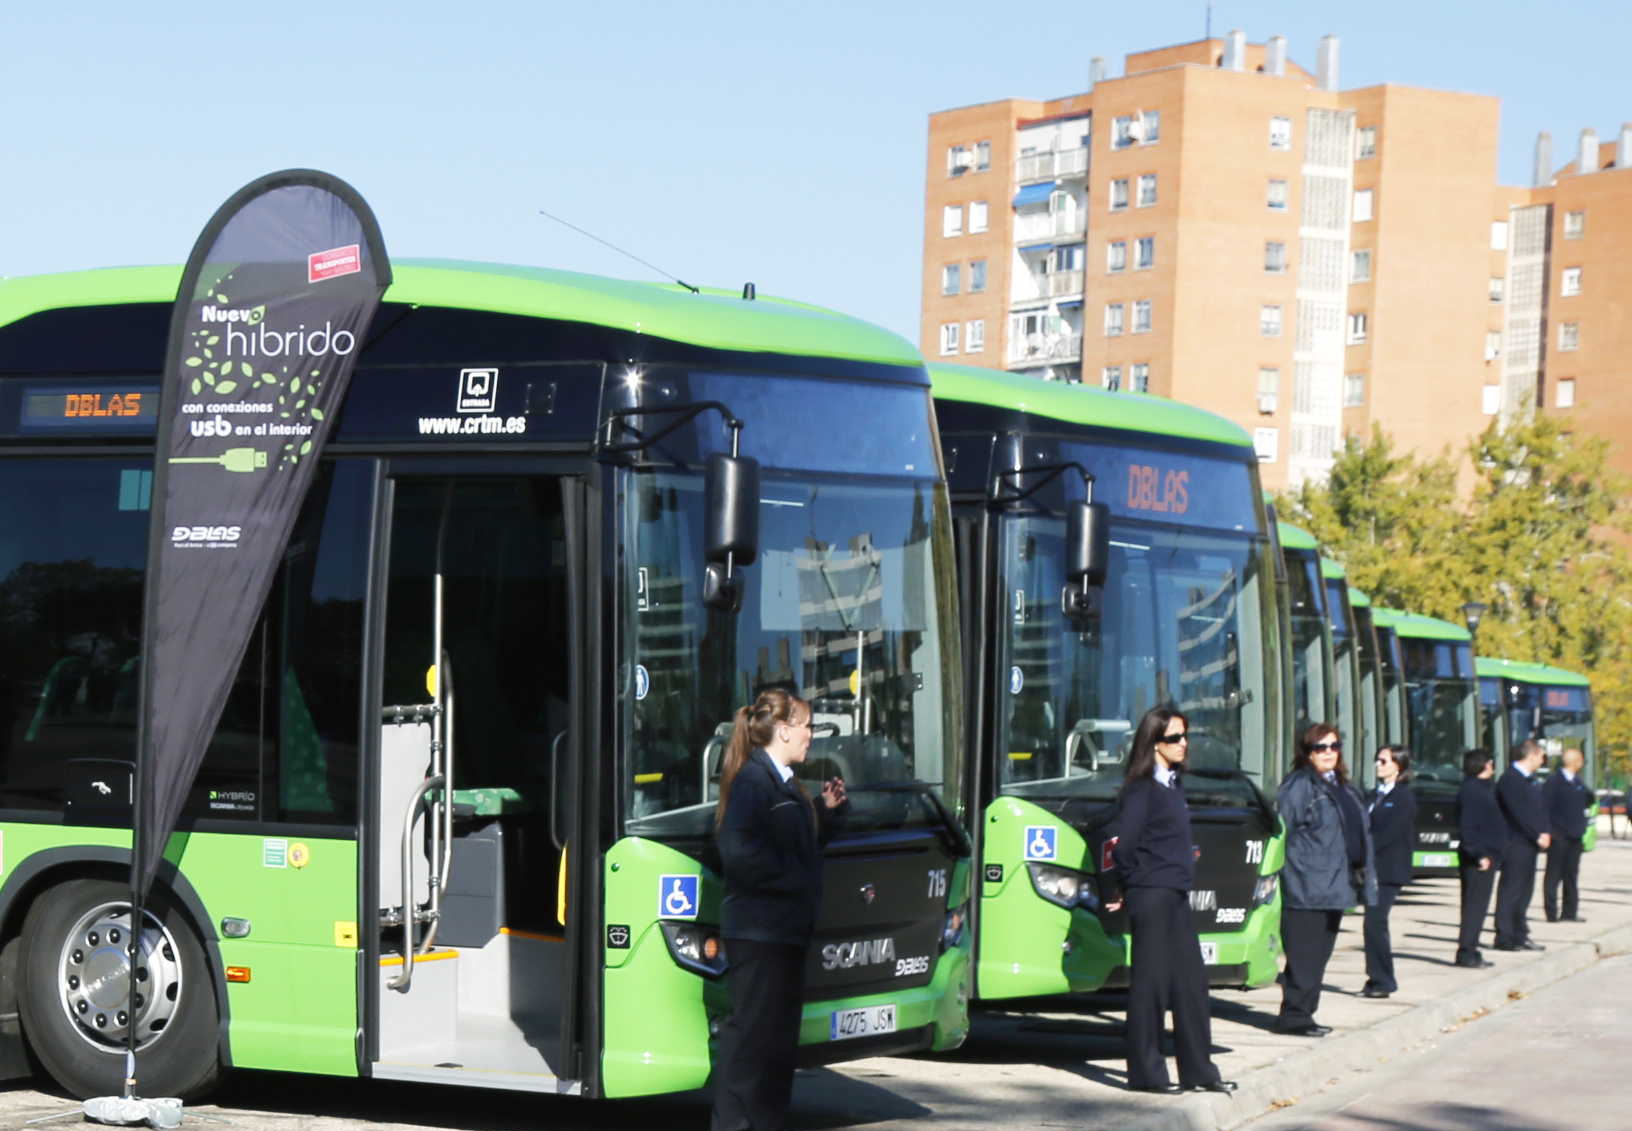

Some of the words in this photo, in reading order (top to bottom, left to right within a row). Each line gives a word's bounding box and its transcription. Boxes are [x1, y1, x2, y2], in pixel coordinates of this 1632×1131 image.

[202, 305, 264, 323] Nuevo
[65, 393, 141, 417] DBLAS
[182, 403, 204, 413] con
[206, 401, 273, 413] conexiones
[191, 414, 232, 437] usb
[235, 425, 251, 435] en
[254, 423, 267, 435] el
[269, 423, 312, 435] interior
[418, 414, 526, 434] www.crtm.es
[1128, 464, 1189, 513] DBLAS
[171, 526, 241, 541] DBLAS
[1245, 840, 1263, 864] 713
[927, 869, 947, 898] 715
[822, 937, 896, 970] SCANIA
[894, 956, 929, 976] DBLAS
[839, 1011, 867, 1035] 4275
[873, 1008, 895, 1031] JSW
